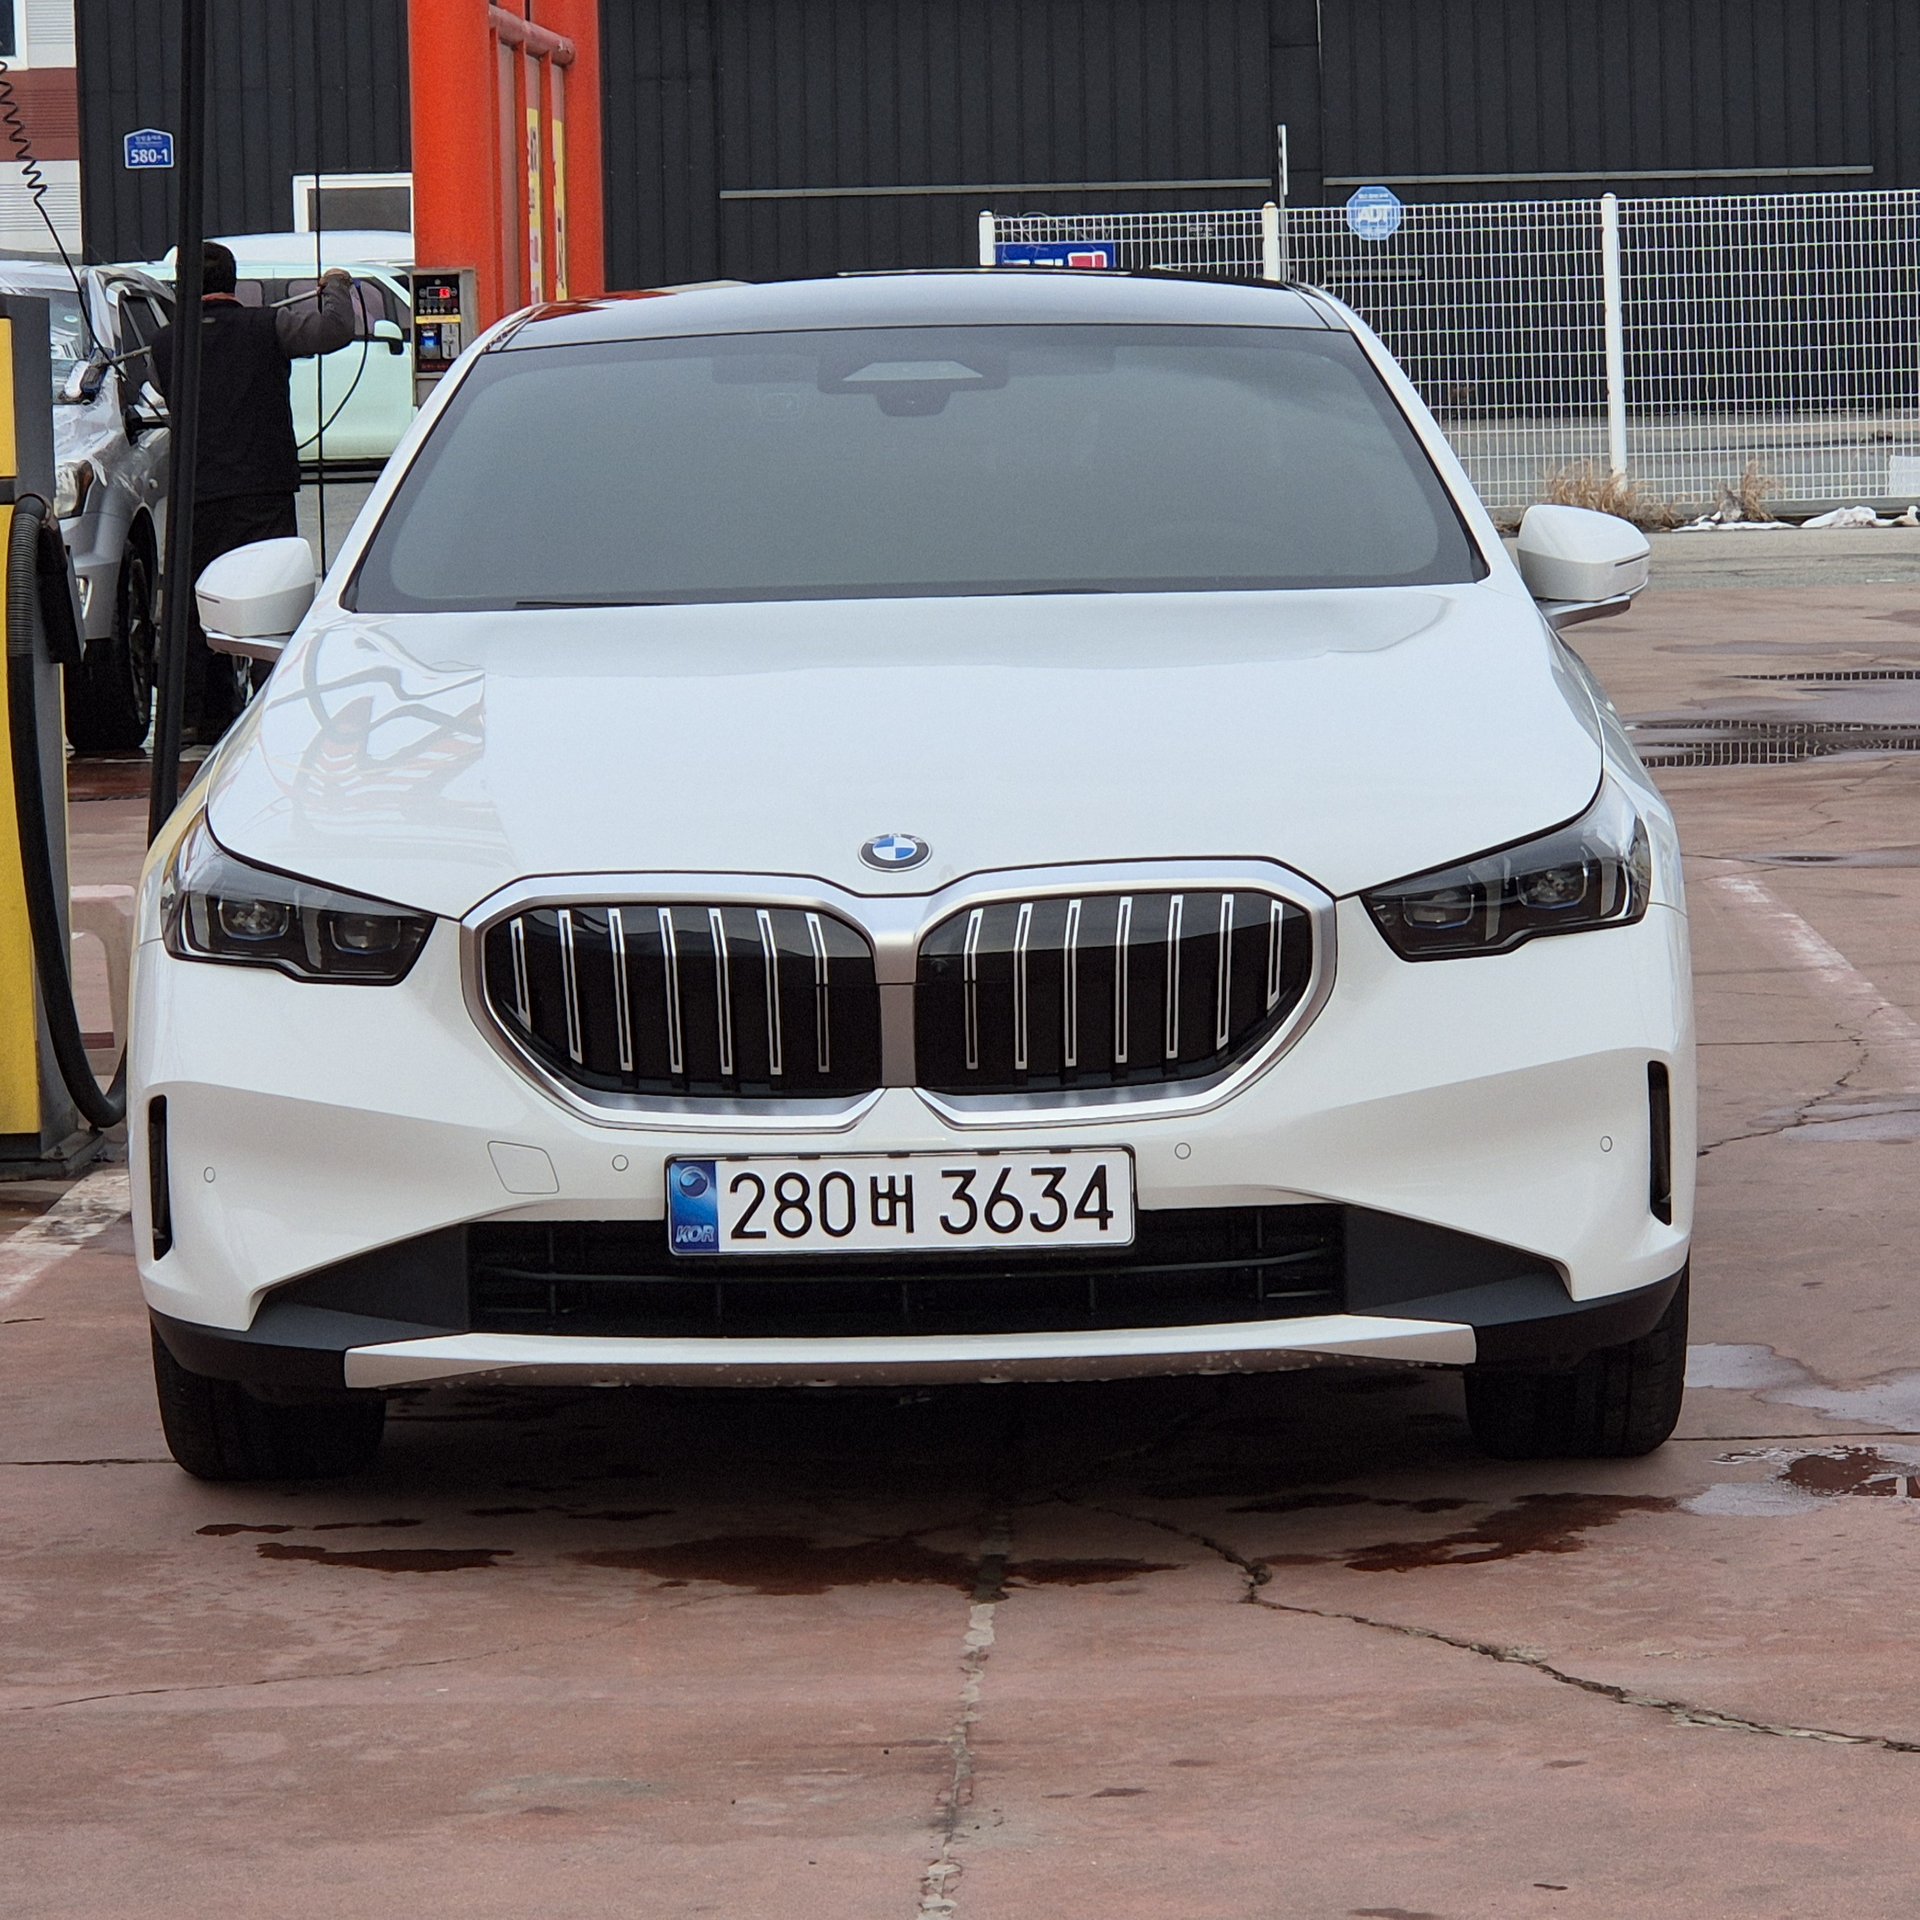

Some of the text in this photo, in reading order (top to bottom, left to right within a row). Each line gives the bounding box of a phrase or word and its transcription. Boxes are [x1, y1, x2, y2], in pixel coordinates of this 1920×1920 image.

[131, 148, 168, 164] 580-1
[729, 1164, 1114, 1239] 280버 3634
[675, 1225, 715, 1243] KOR
